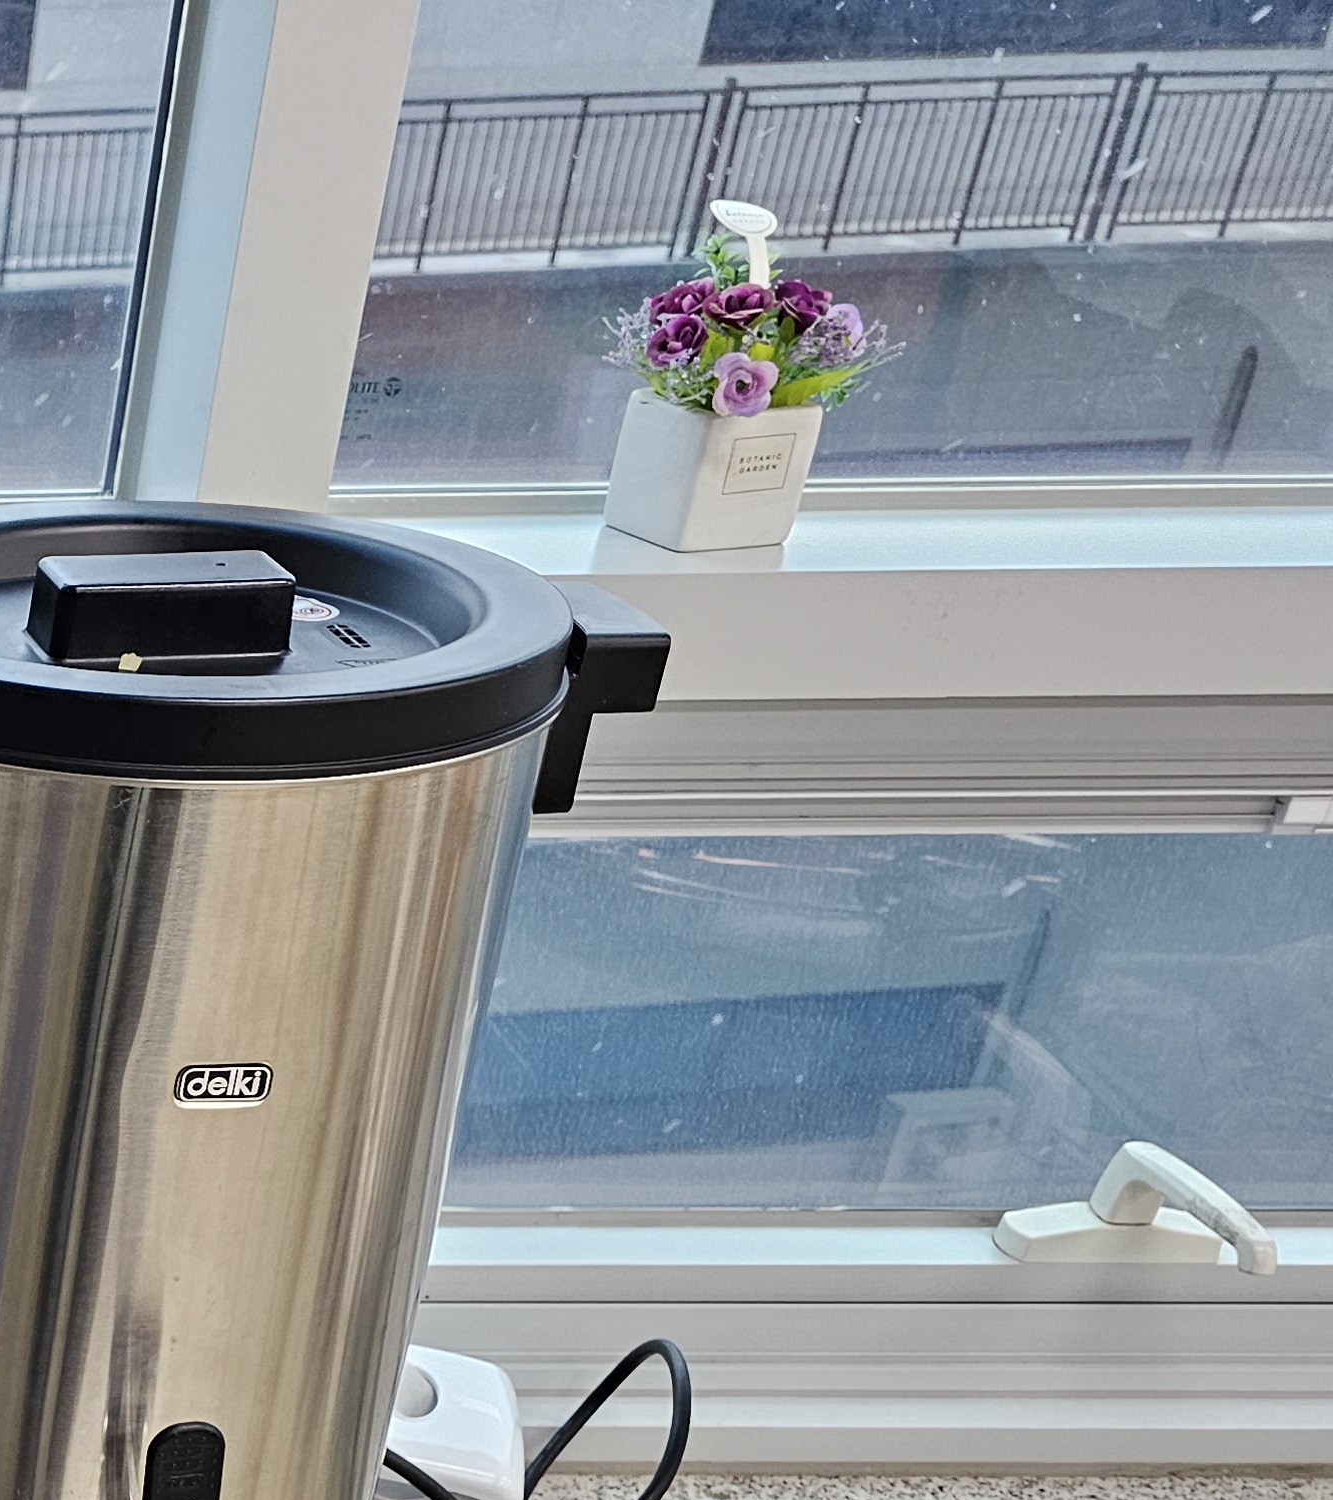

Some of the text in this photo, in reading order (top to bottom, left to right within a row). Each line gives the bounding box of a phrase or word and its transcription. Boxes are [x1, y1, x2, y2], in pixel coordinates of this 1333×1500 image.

[739, 453, 782, 464] BOTANIC
[739, 464, 778, 474] GARDEN
[186, 1069, 262, 1097] delki
